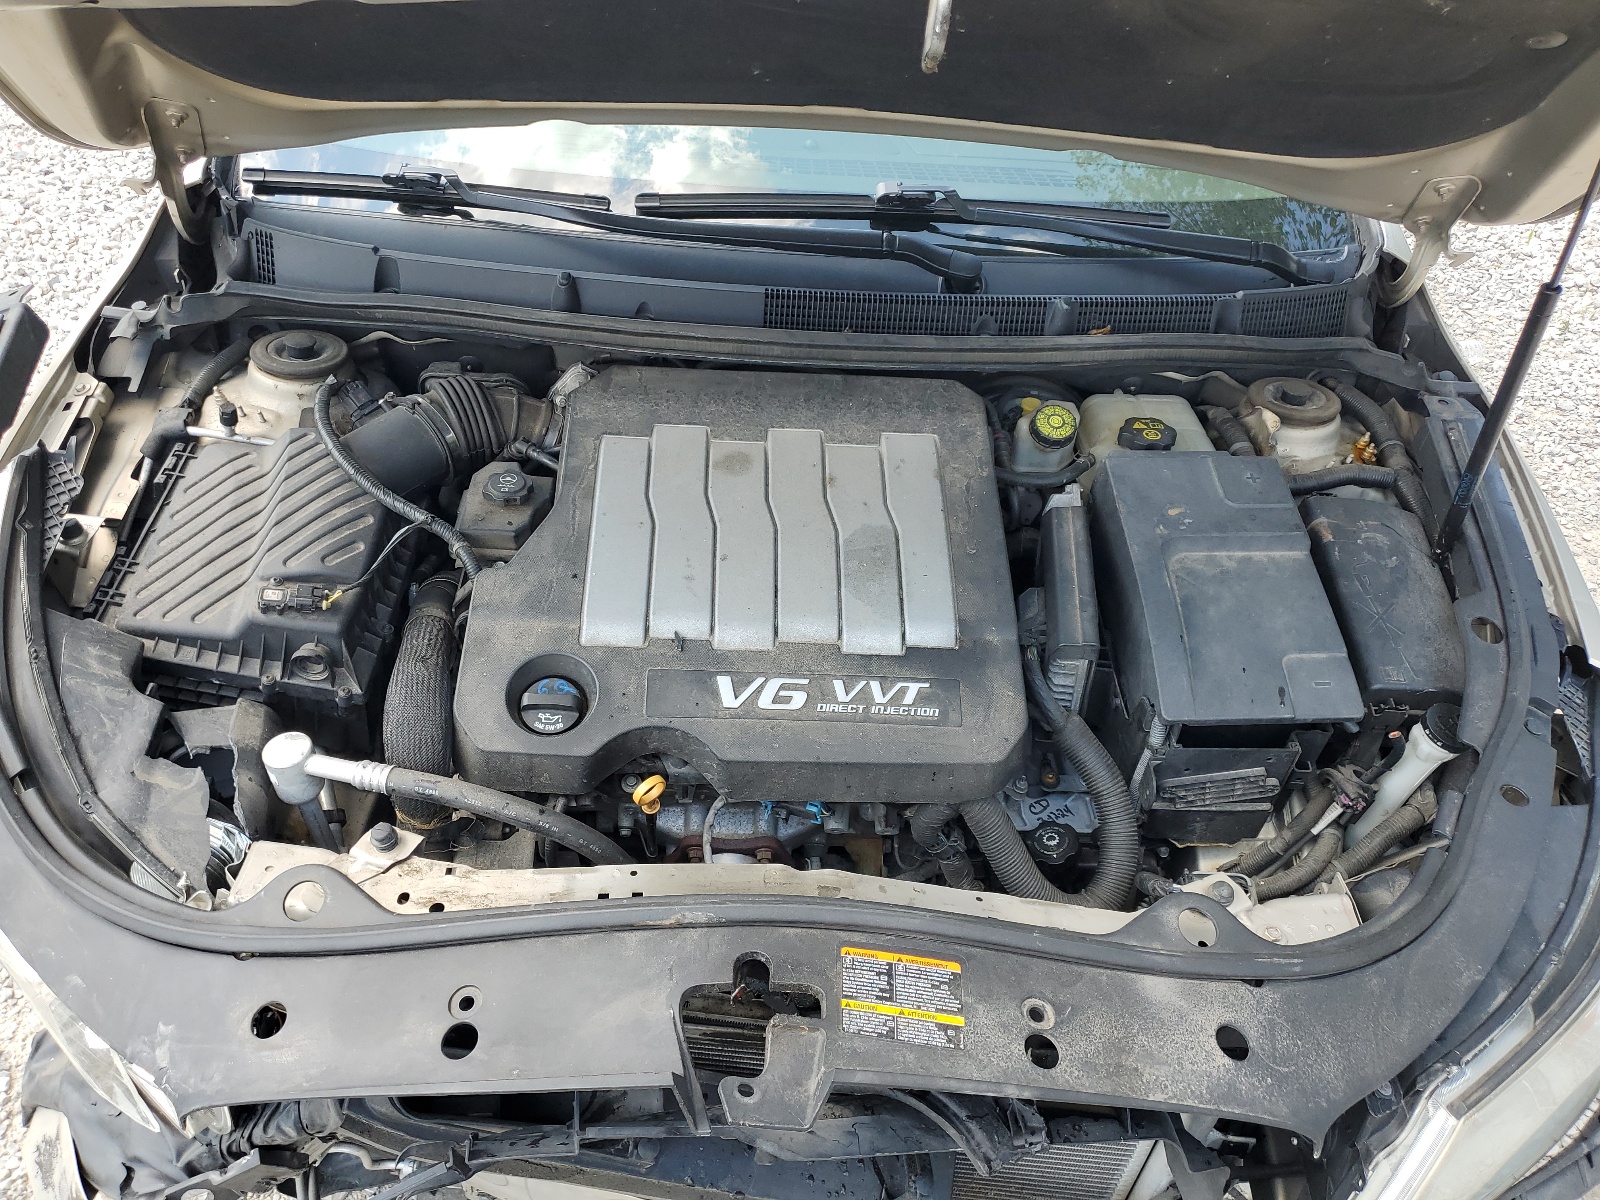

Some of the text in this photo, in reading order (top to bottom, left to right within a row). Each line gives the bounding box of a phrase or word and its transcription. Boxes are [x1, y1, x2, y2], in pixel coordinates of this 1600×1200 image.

[717, 675, 931, 711] V6 VVT
[816, 703, 940, 717] DIRECT INJECTION
[533, 721, 545, 730] SAE
[852, 951, 949, 970] WARNING AVERTISSEMENT
[853, 1002, 878, 1012] CAUTION
[907, 1011, 937, 1021] ATTENTION
